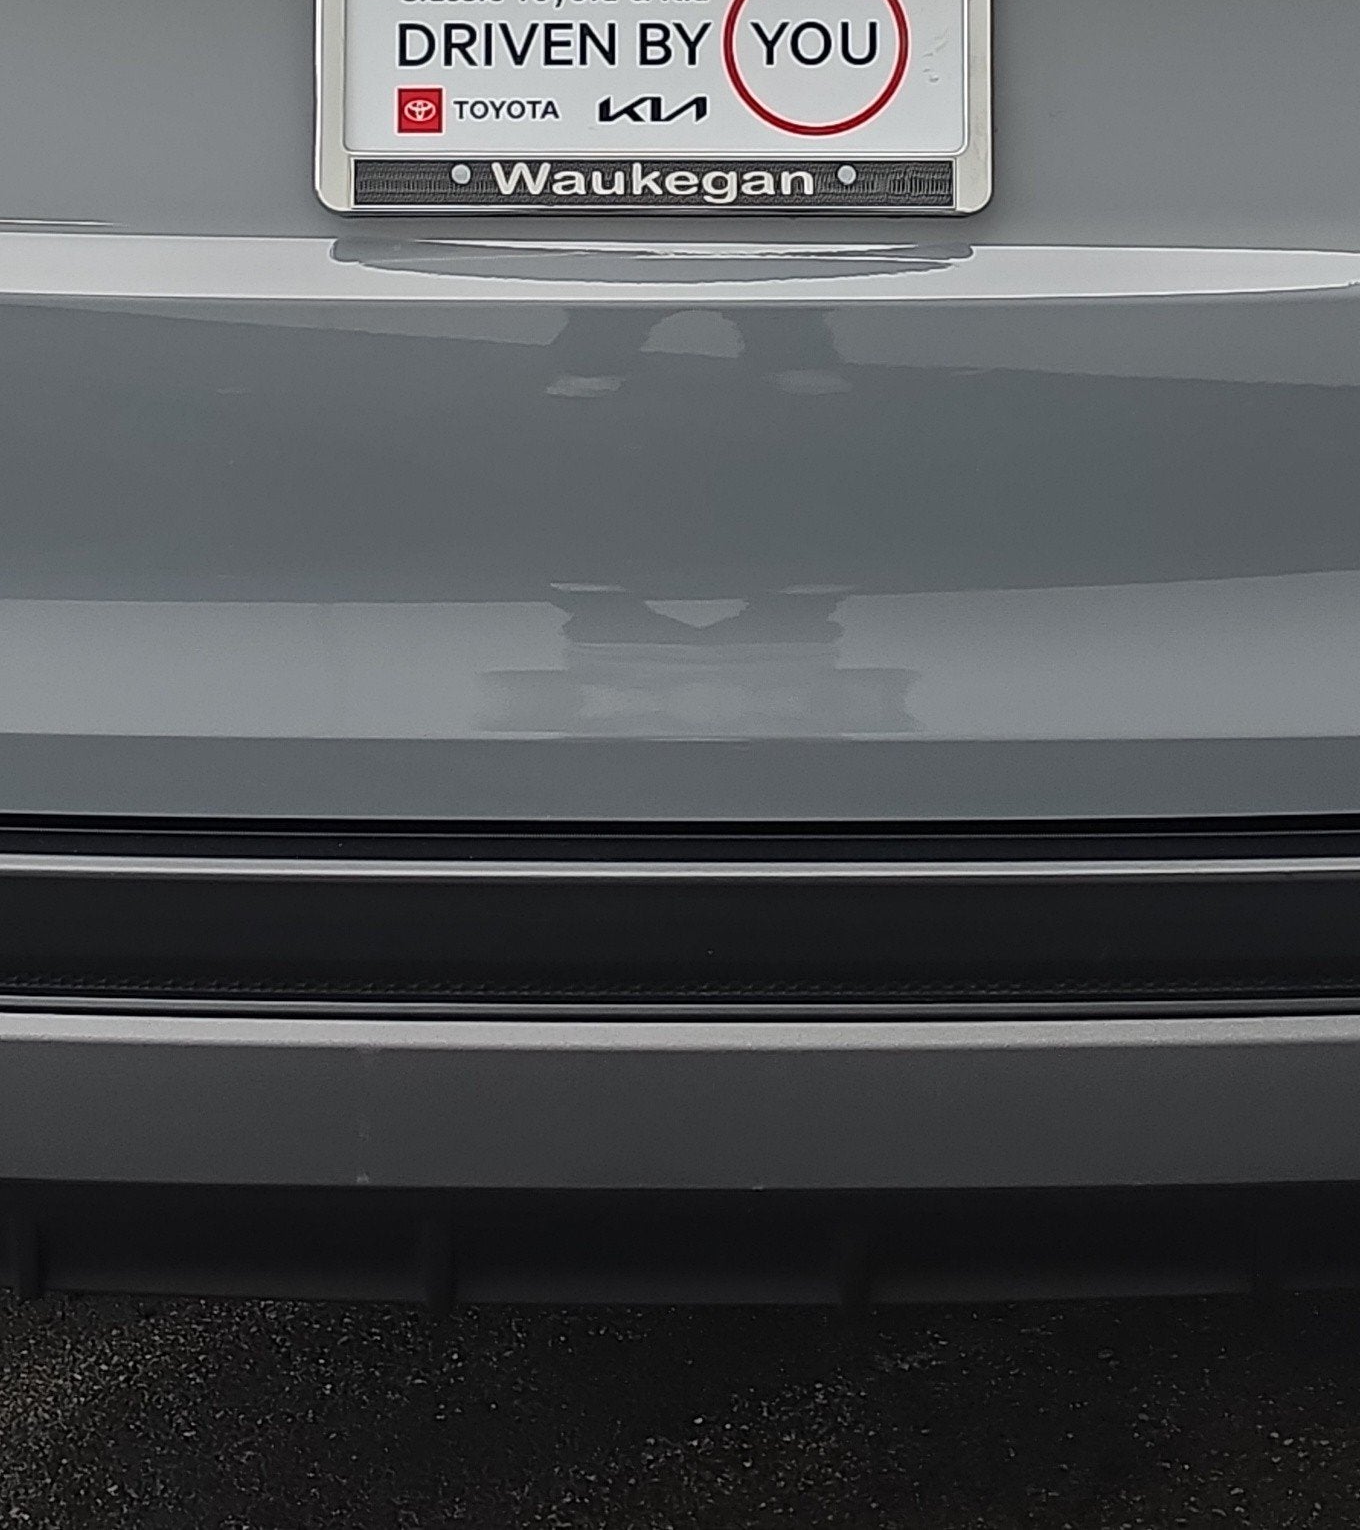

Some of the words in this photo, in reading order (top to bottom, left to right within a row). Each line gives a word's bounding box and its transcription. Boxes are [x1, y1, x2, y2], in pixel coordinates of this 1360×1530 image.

[398, 22, 616, 66] DRIVEN
[639, 22, 712, 66] BY
[750, 21, 877, 65] YOU
[453, 100, 559, 120] TOYOTA
[491, 162, 814, 203] Waukegan
